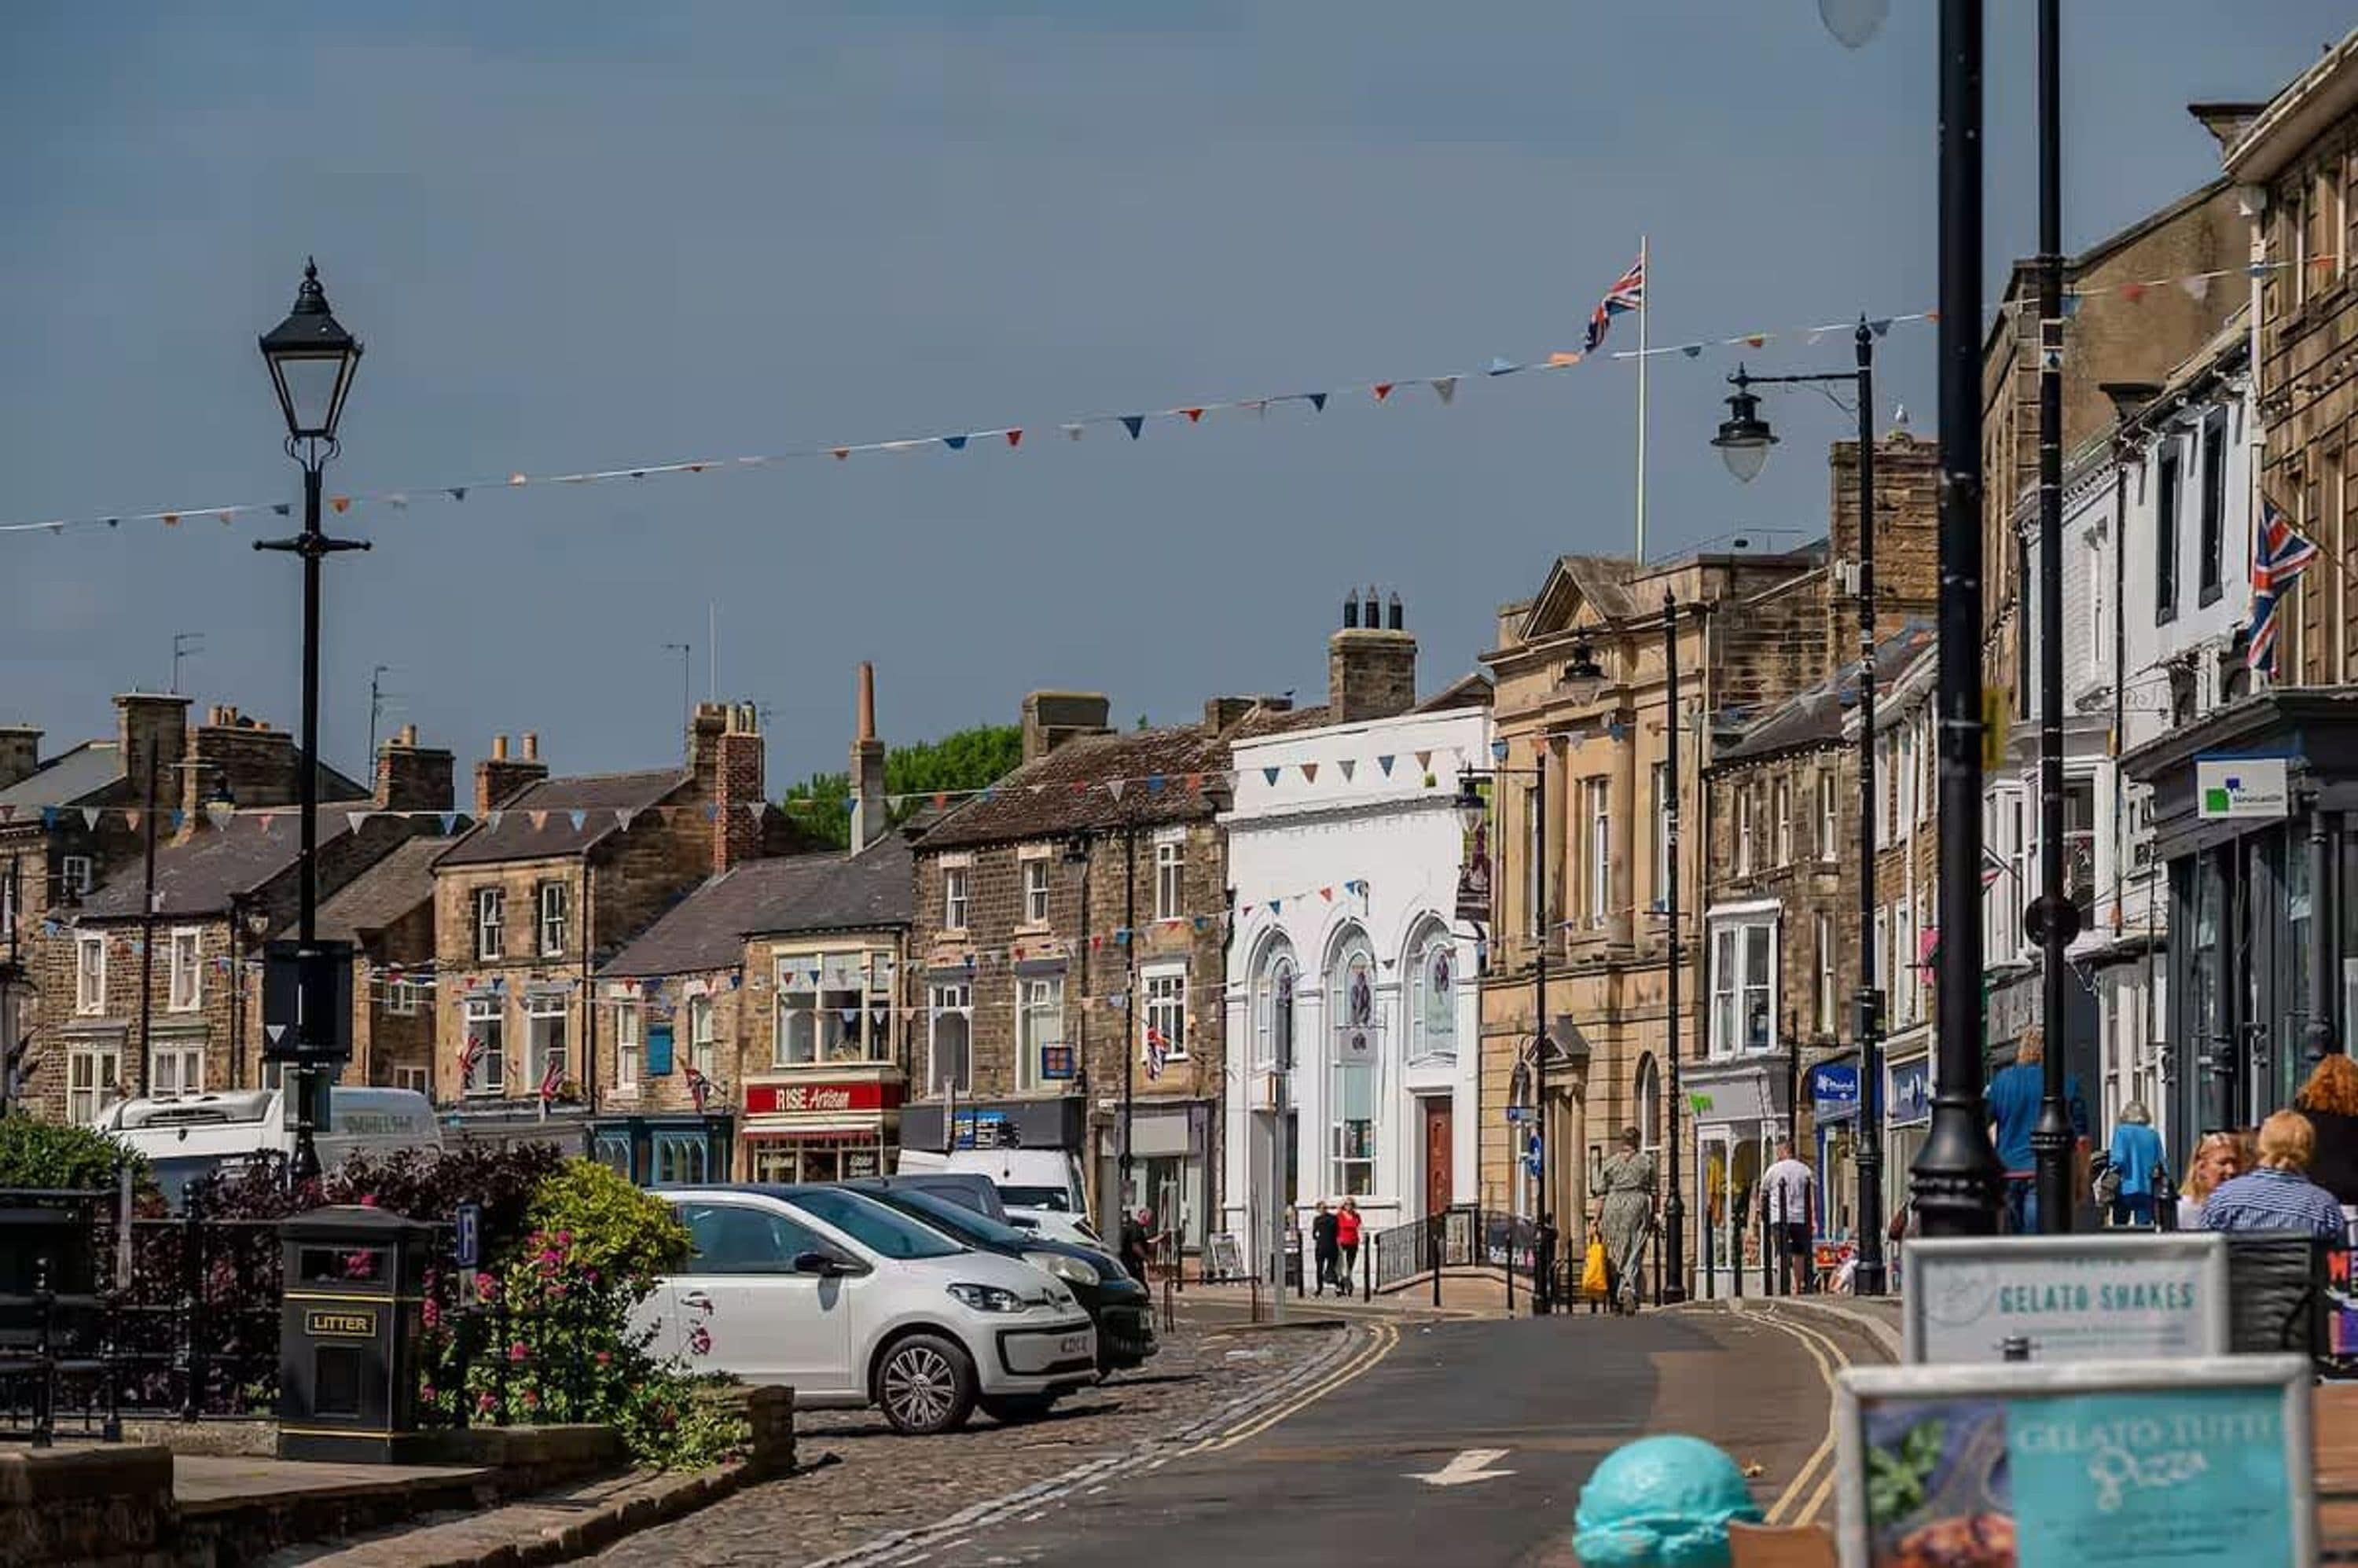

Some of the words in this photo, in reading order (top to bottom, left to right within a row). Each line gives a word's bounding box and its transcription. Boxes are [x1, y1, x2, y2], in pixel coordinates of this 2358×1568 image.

[776, 1087, 806, 1110] RISE
[809, 1087, 850, 1109] Artisan
[1999, 1283, 2089, 1313] GELATO
[2100, 1281, 2198, 1311] SHAKES
[314, 1316, 367, 1331] LITTER
[2017, 1417, 2163, 1452] GELATO
[2170, 1412, 2277, 1445] TUTTI
